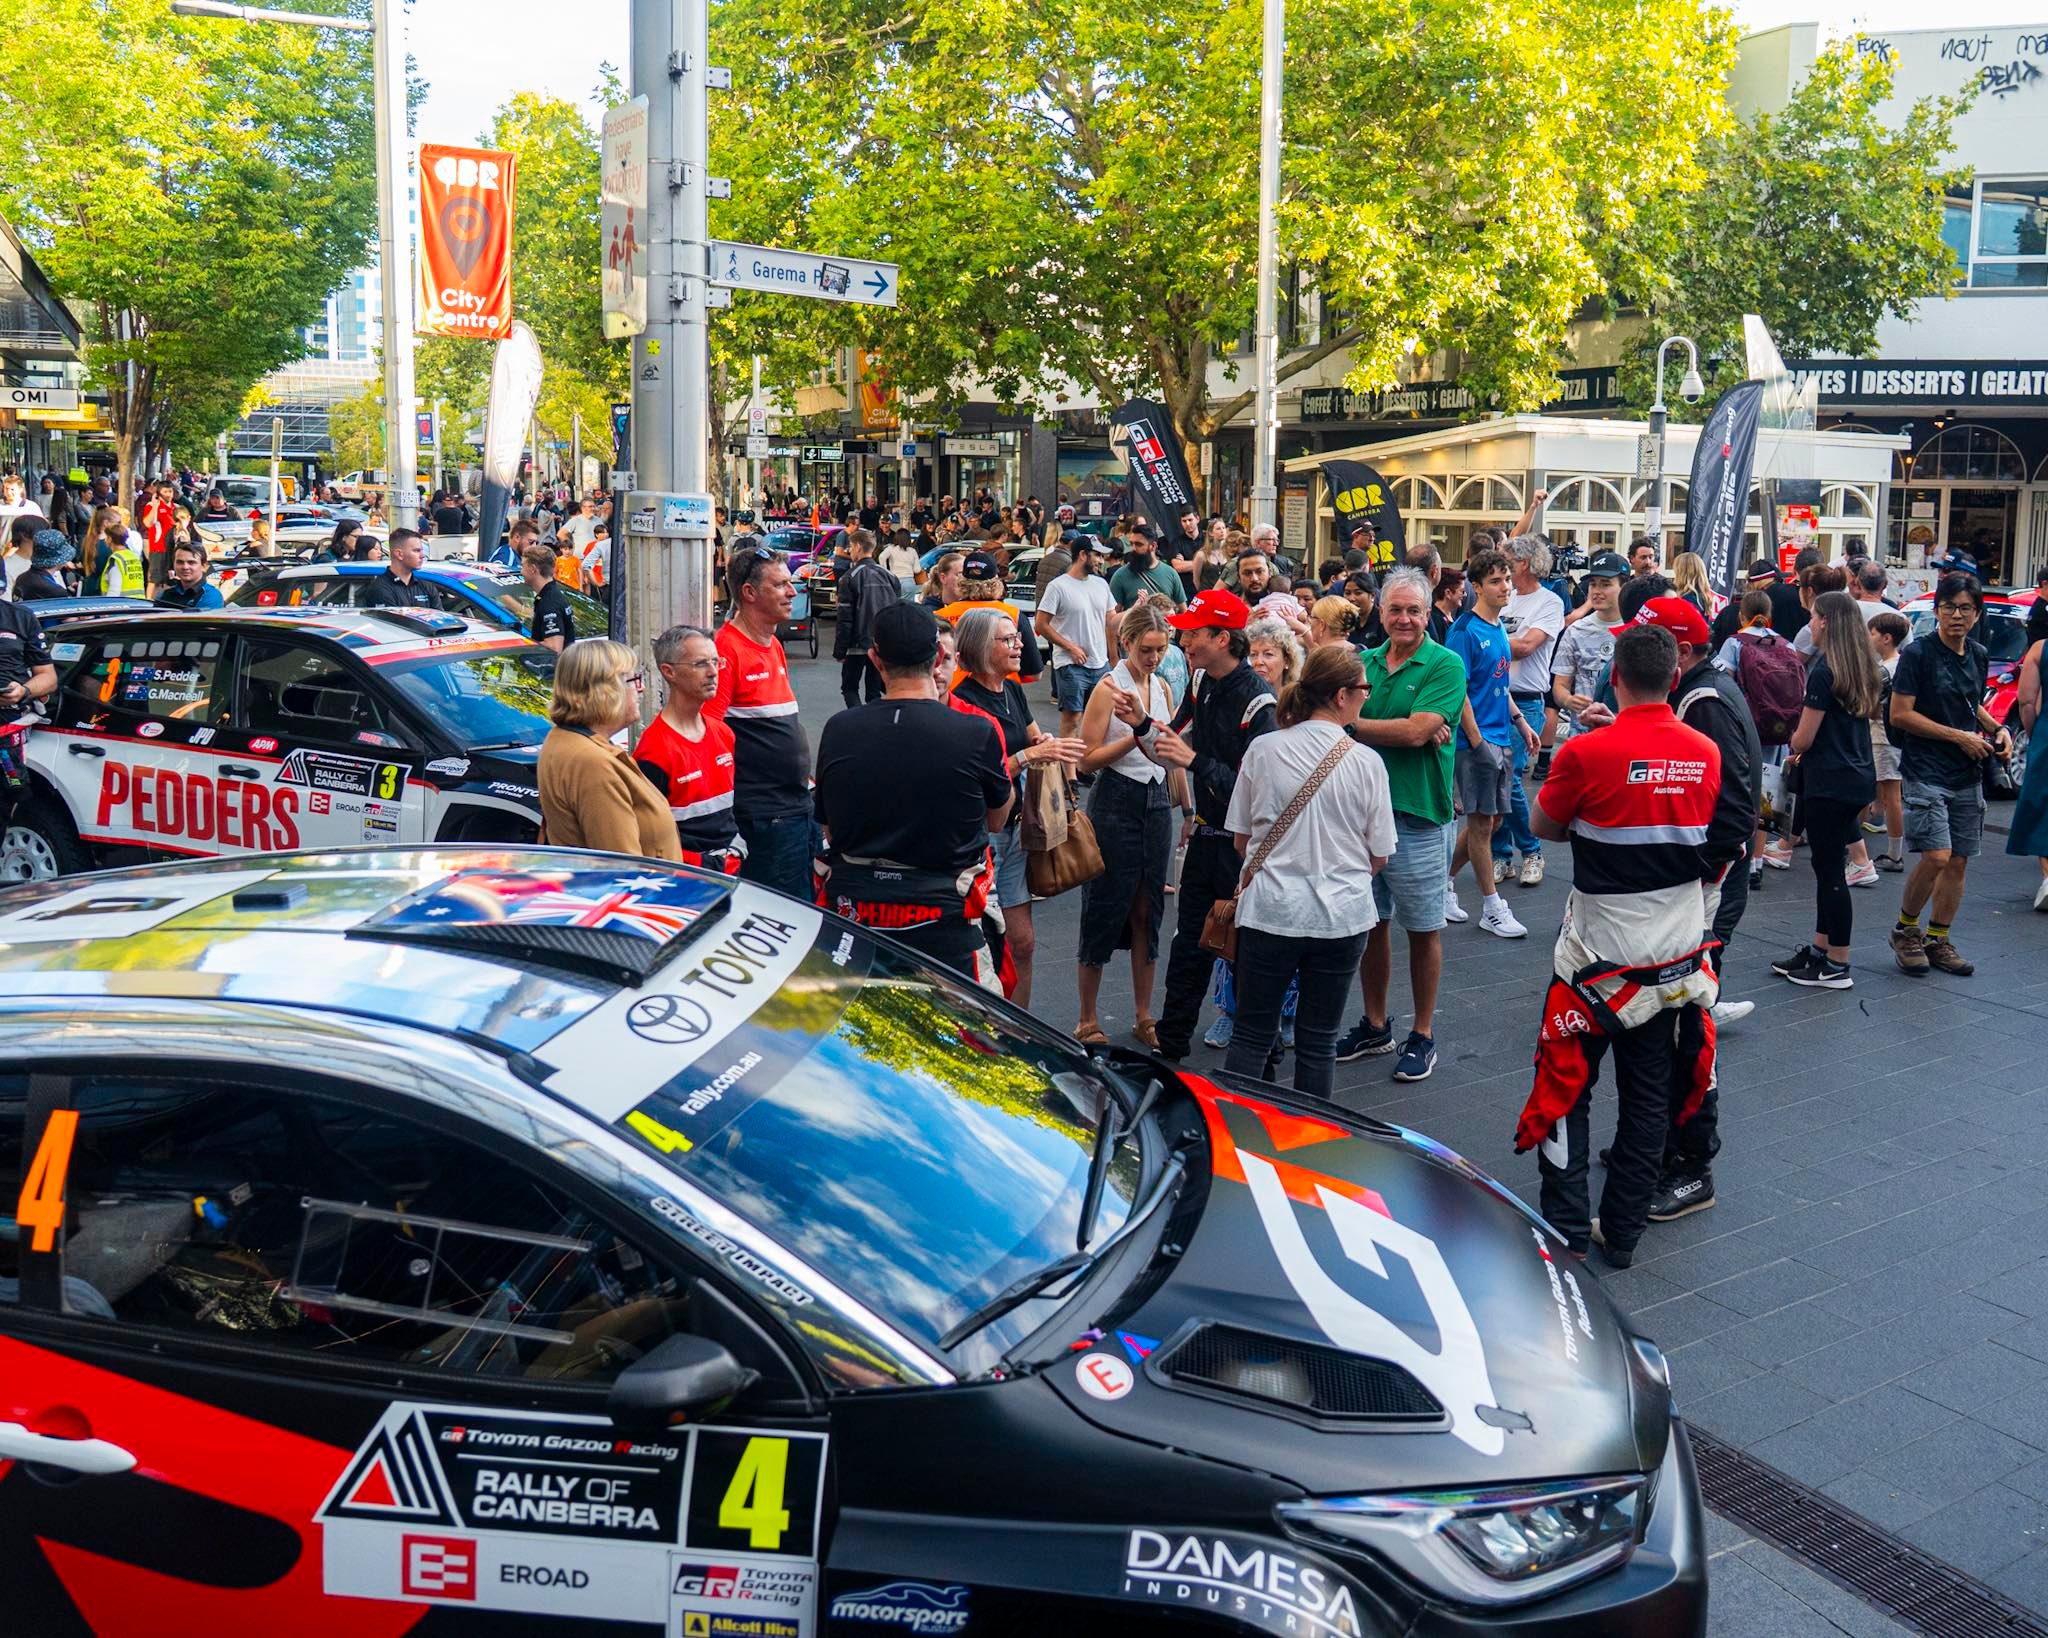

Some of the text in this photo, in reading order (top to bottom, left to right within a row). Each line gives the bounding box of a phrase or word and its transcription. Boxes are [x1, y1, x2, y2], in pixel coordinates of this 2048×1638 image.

[604, 110, 644, 141] Pedestrians
[615, 140, 632, 161] have
[753, 261, 806, 283] Garema
[441, 288, 486, 313] City
[428, 306, 499, 329] Centre
[1565, 378, 1588, 400] IZZA
[1861, 370, 1966, 396] DESSERTS
[1981, 370, 2048, 396] GELAT
[12, 390, 47, 403] OMI
[1304, 395, 1331, 415] COFFEE
[1343, 394, 1371, 413] CAKES
[1383, 390, 1428, 411] DESSERTS
[872, 408, 890, 418] City
[1128, 423, 1156, 462] GR
[1129, 456, 1152, 491] Australia
[1147, 463, 1173, 506] Racing
[1155, 461, 1179, 503] GAZOO
[1164, 459, 1187, 505] TOYOTA
[1336, 484, 1385, 513] CBR
[1347, 508, 1381, 521] CANBERRA
[1367, 540, 1396, 564] BR
[99, 658, 120, 703] 3
[153, 669, 201, 683] S.Pedder
[250, 738, 275, 751] APM
[315, 769, 358, 783] RALLY OF
[1629, 768, 1664, 782] GR
[1667, 767, 1704, 775] GAZOO
[1668, 760, 1707, 768] TOYOTA
[313, 777, 366, 793] CANBERRA
[379, 765, 398, 799] 3
[1653, 786, 1685, 795] Australia
[1666, 774, 1702, 784] Racing
[96, 760, 300, 851] PEDDERS
[336, 803, 361, 814] EROAD
[874, 870, 902, 881] rpm
[680, 912, 797, 999] TOYOTA
[680, 1051, 763, 1116] rally.com.au
[625, 1109, 693, 1154] 4
[16, 1110, 79, 1253] 4
[1674, 1180, 1702, 1198] sparco
[651, 1196, 815, 1306] STREET IMPACT
[1086, 1360, 1125, 1393] E
[440, 1428, 679, 1462] GR TOYOTA GAZOO Racing
[475, 1469, 631, 1503] RALLY OF
[719, 1437, 790, 1550] 4
[472, 1494, 661, 1531] CANBERRA
[500, 1564, 590, 1588] EROAD
[672, 1575, 737, 1599] GR
[740, 1579, 805, 1594] GAZOO
[743, 1567, 813, 1583] TOYOTA
[1127, 1529, 1362, 1638] DAMESA
[738, 1590, 801, 1607] Racing
[1124, 1578, 1337, 1638] INDUSTRI
[712, 1617, 762, 1634] Allcott
[764, 1621, 798, 1637] Hire
[831, 1601, 969, 1631] motorsport
